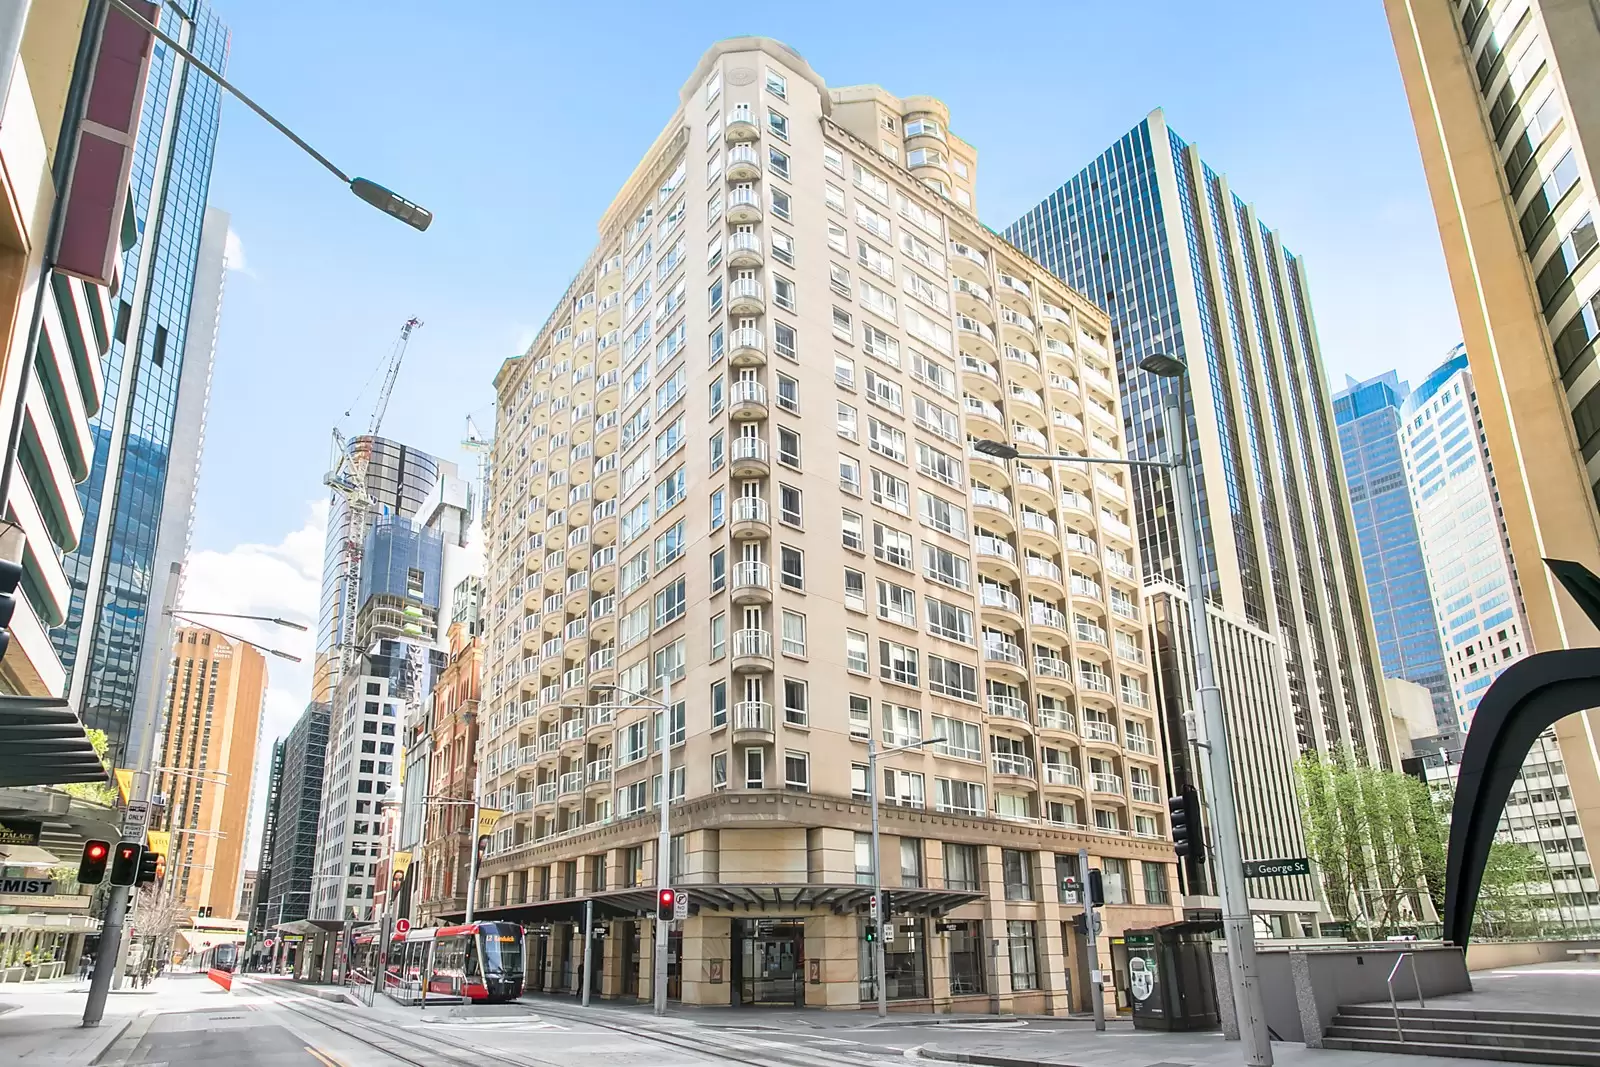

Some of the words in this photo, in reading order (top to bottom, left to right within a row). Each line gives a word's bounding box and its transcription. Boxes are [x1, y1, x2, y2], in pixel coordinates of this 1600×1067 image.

[3, 832, 33, 840] PALACE
[1259, 865, 1293, 874] George
[1294, 862, 1305, 871] St
[400, 922, 406, 931] L
[712, 963, 721, 979] 2
[811, 963, 818, 979] 2
